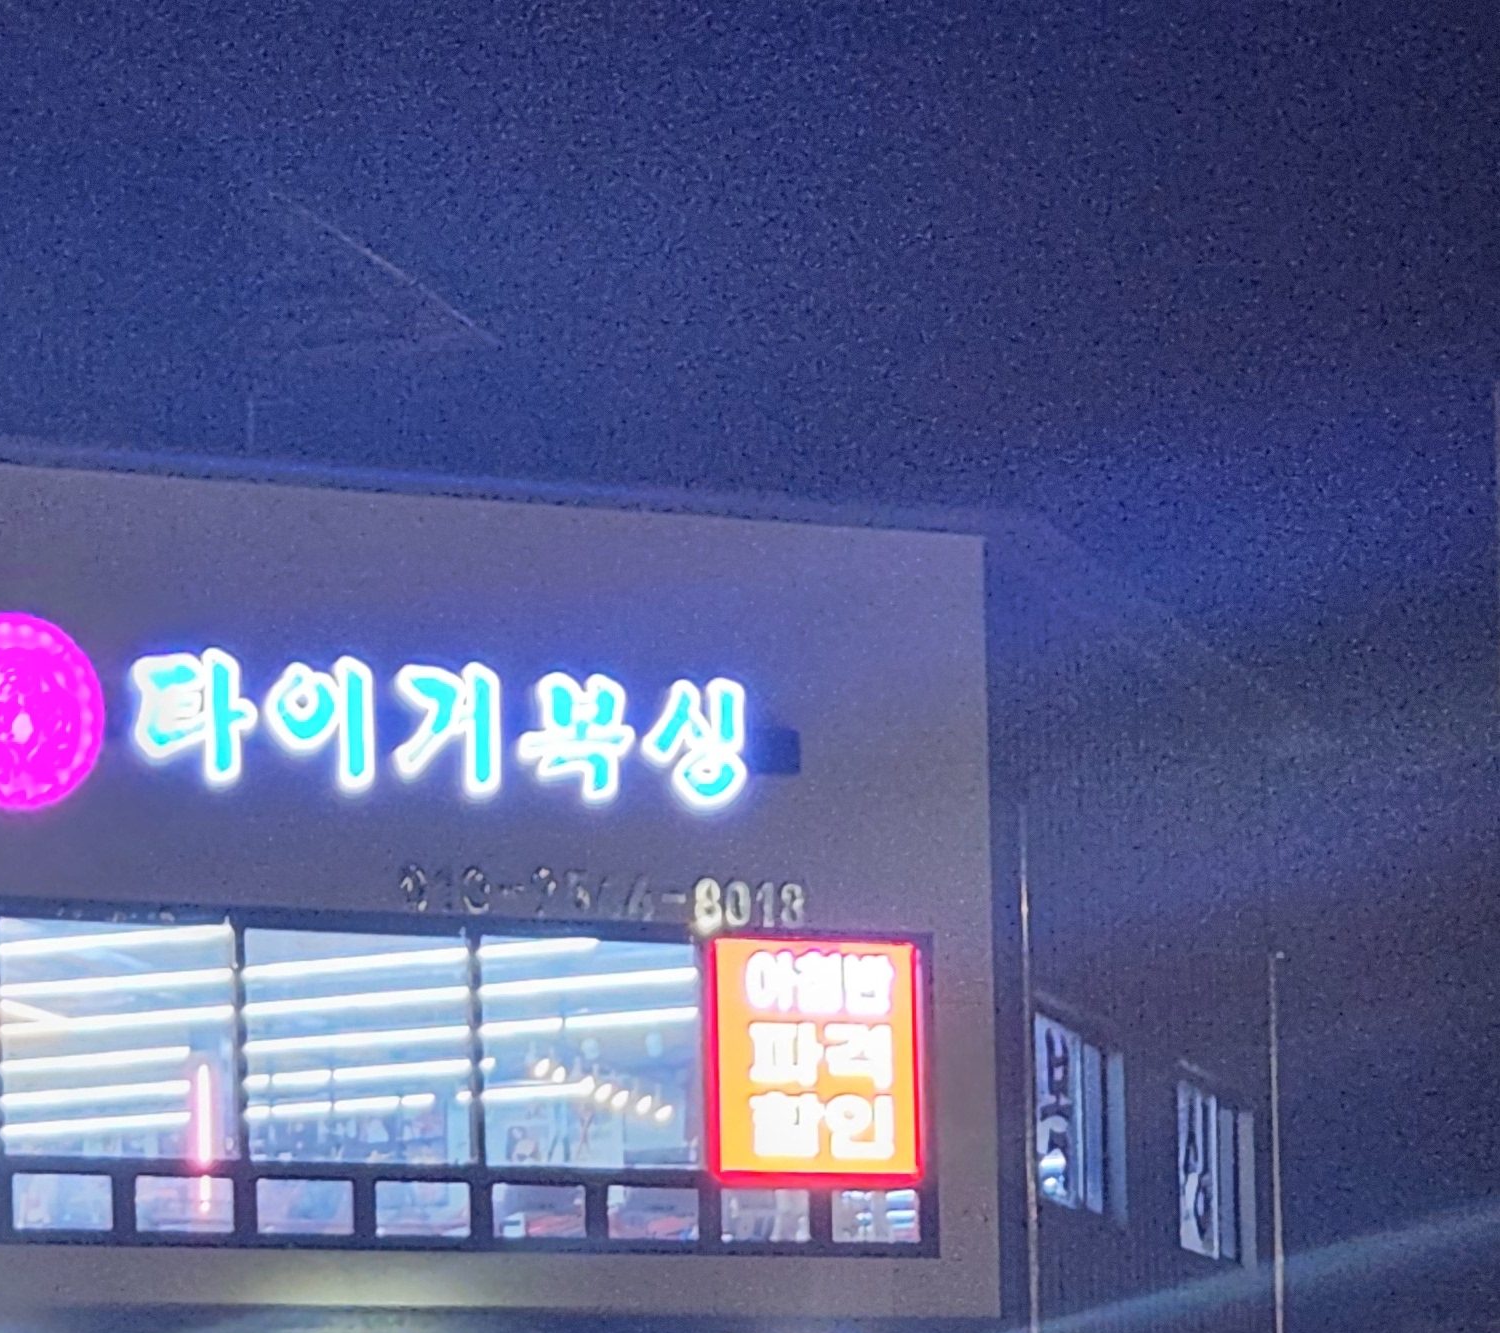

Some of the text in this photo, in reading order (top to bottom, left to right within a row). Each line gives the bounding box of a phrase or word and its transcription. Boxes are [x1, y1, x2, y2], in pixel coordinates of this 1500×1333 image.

[130, 647, 749, 808] 타이거복싱
[748, 1021, 894, 1090] 파격
[748, 1090, 896, 1160] 할인
